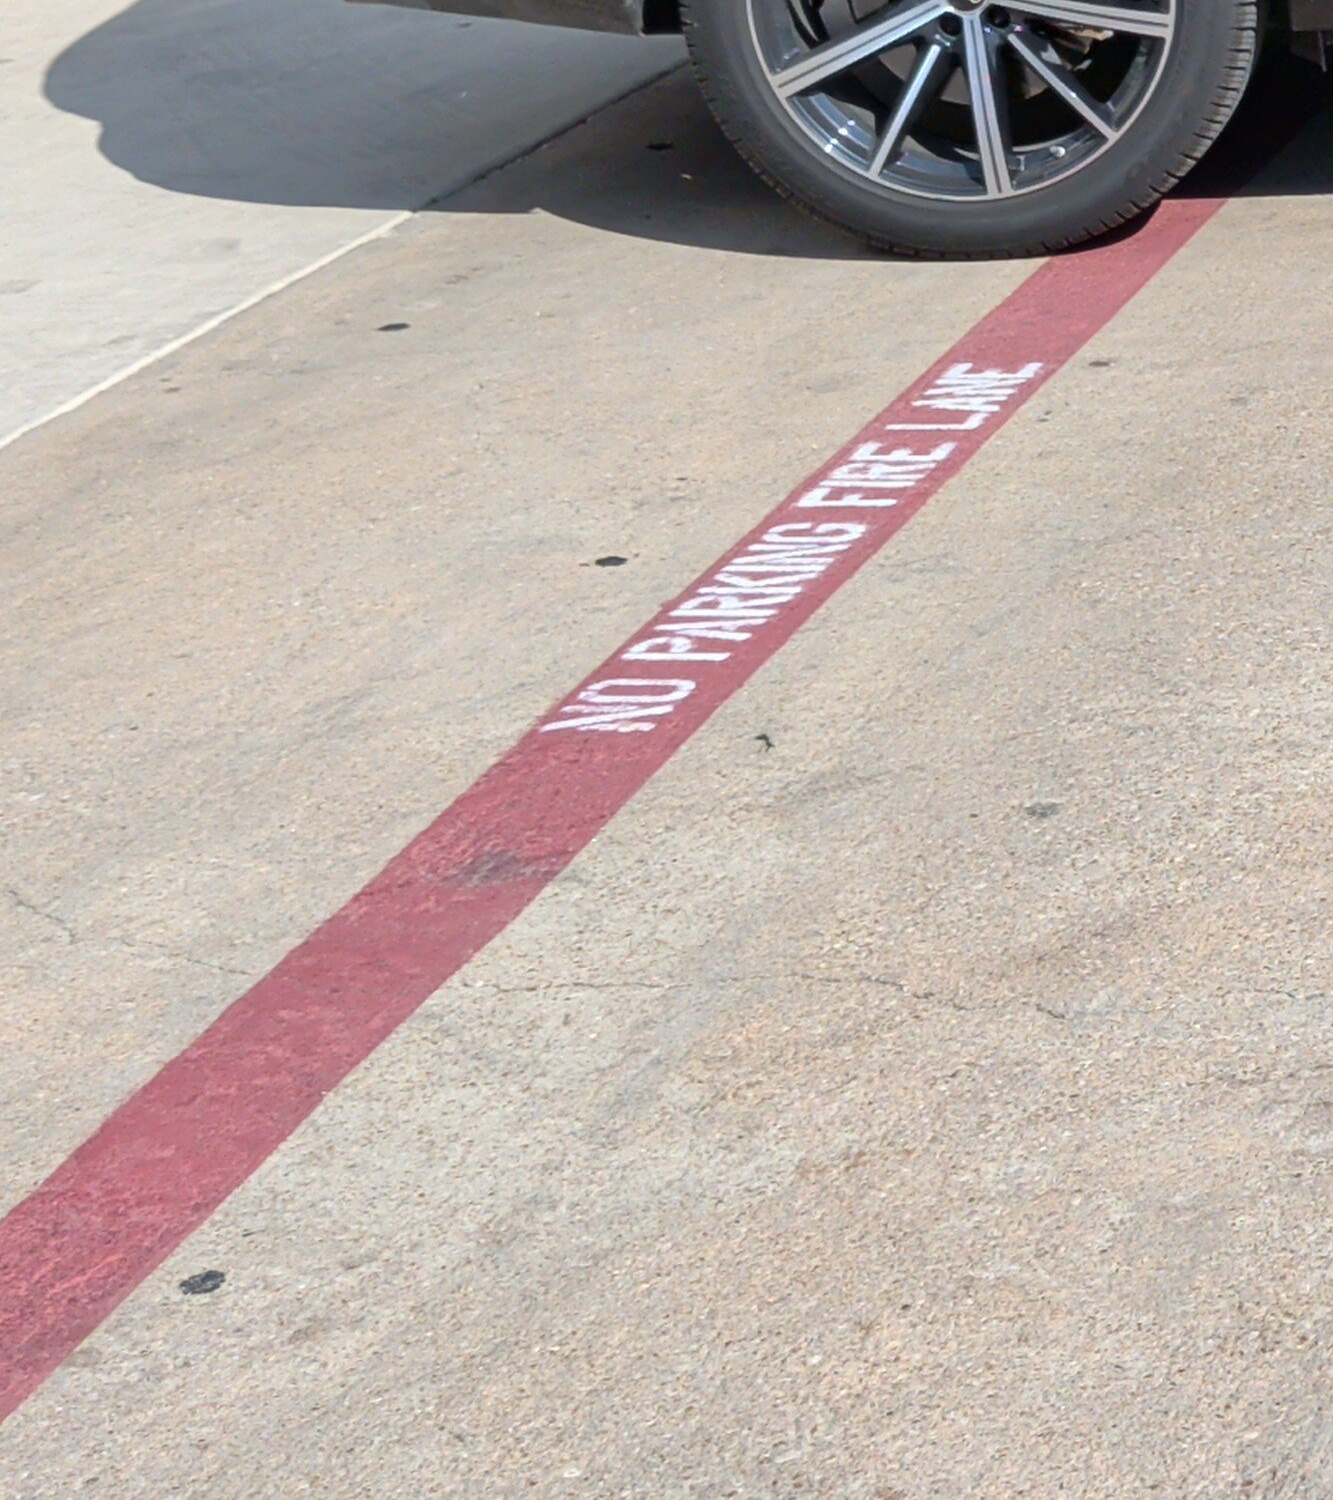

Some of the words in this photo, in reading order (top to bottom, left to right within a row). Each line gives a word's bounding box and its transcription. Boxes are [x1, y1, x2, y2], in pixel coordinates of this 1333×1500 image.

[540, 677, 697, 733] NO
[620, 521, 867, 662] PARKING
[794, 441, 957, 507] FIRE
[884, 361, 1045, 431] LANE
